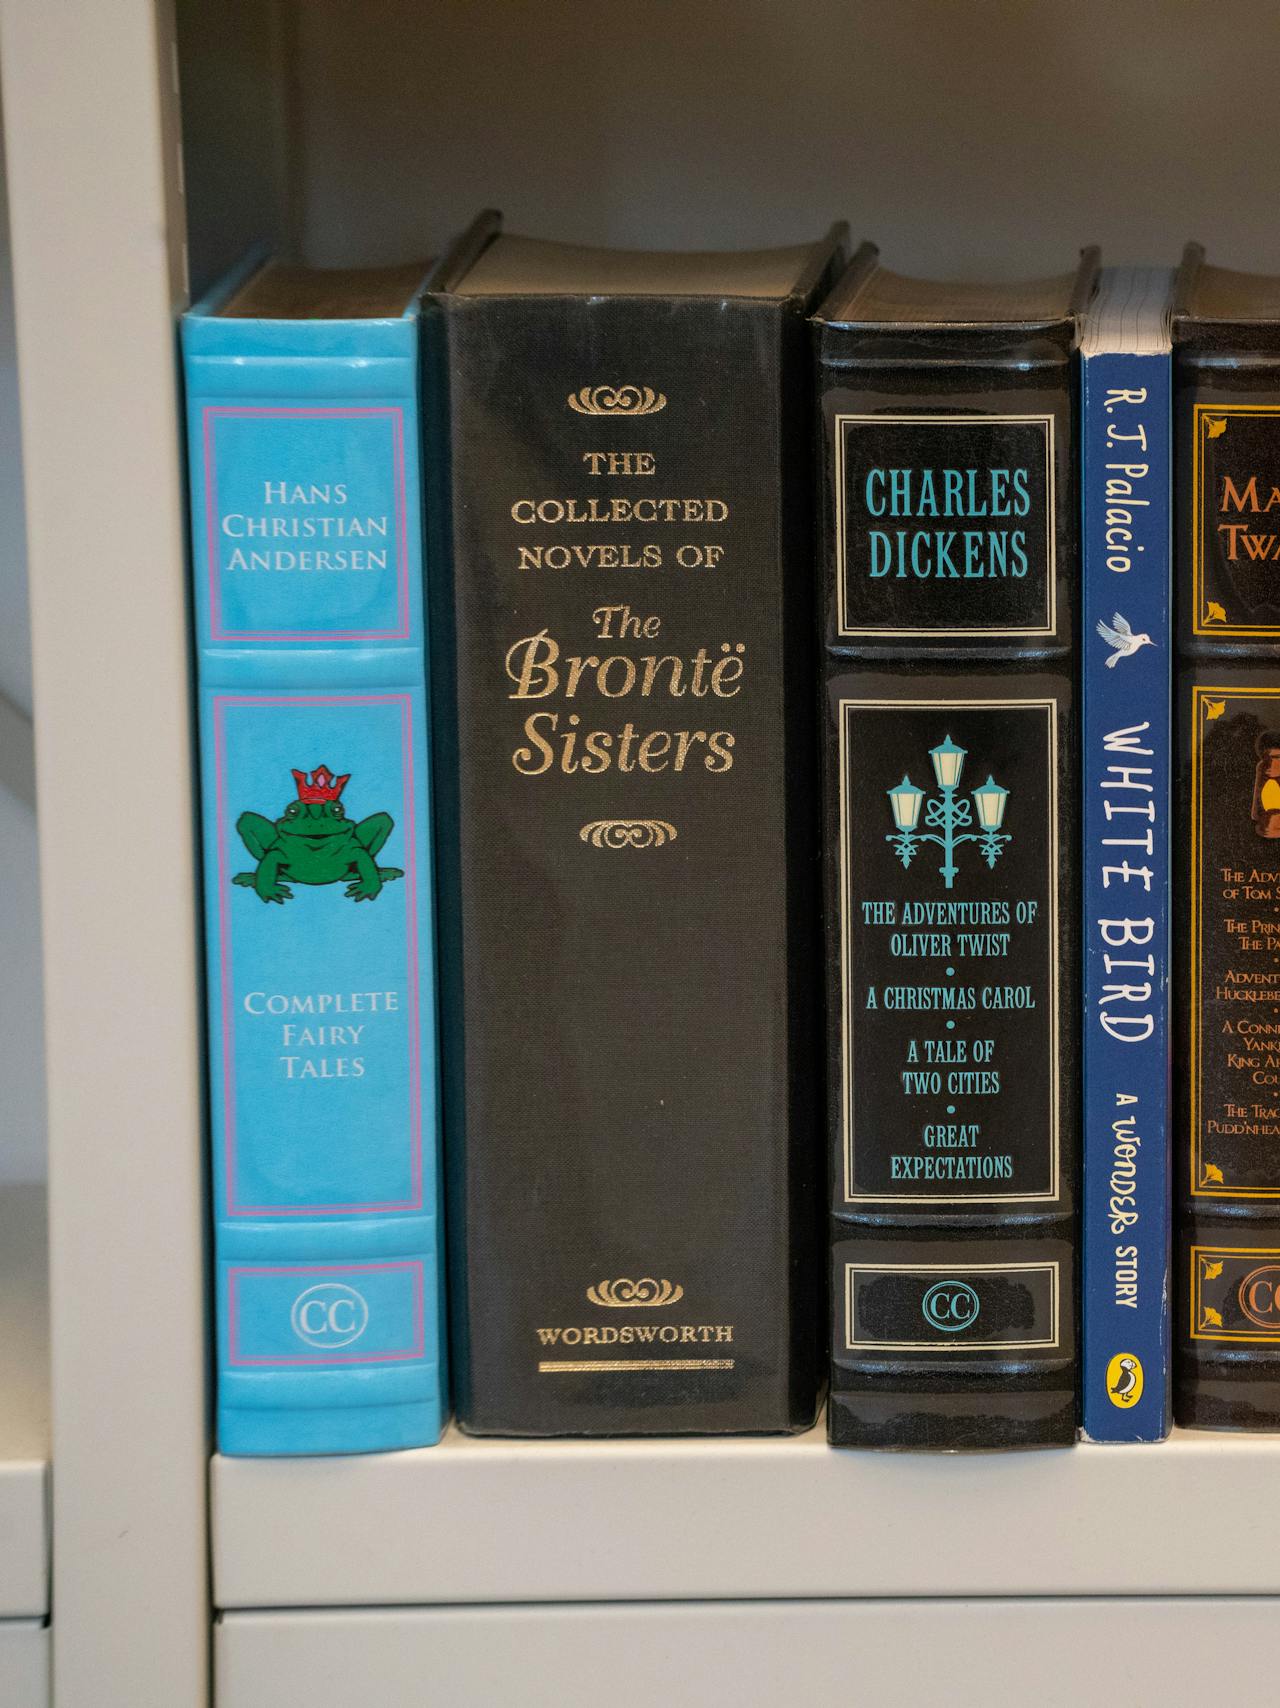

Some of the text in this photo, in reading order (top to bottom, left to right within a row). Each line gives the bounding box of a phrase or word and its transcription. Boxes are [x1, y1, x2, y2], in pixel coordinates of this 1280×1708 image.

[582, 452, 655, 476] THE
[1105, 387, 1150, 572] R. J. Palacio
[263, 482, 347, 504] HANS
[865, 468, 1030, 517] CHARLES
[511, 500, 729, 524] COLLECTED
[222, 514, 388, 538] CHRISTIAN
[226, 548, 388, 571] ANDERSEN
[518, 546, 724, 569] NOVELS OF
[869, 530, 1029, 579] DICKENS
[592, 606, 661, 639] The
[505, 629, 746, 699] Brontë
[512, 712, 736, 774] Sisters
[1098, 721, 1155, 1042] WHITE BIRD
[1221, 869, 1244, 883] THE
[1223, 889, 1240, 899] OF
[1242, 886, 1271, 899] TOM
[862, 901, 1037, 926] THE ADVENTURES OF
[1224, 919, 1247, 933] THE
[890, 933, 1010, 957] OLIVER TWIST
[1239, 937, 1262, 950] THE
[244, 991, 399, 1015] COMPLETE
[866, 987, 1035, 1010] A CHRISTMAS CAROL
[282, 1024, 365, 1046] FAIRY
[1222, 1021, 1234, 1034] A
[907, 1040, 995, 1063] A TALE OF
[1227, 1055, 1260, 1068] KING
[280, 1056, 366, 1078] TALES
[902, 1072, 1000, 1095] TWO CITIES
[1115, 1093, 1138, 1106] A
[1224, 1104, 1247, 1117] THE
[923, 1125, 979, 1148] GREAT
[890, 1156, 1013, 1180] EXPECTATIONS
[1115, 1246, 1138, 1309] STORY
[537, 1325, 734, 1346] WORDSWORTH
